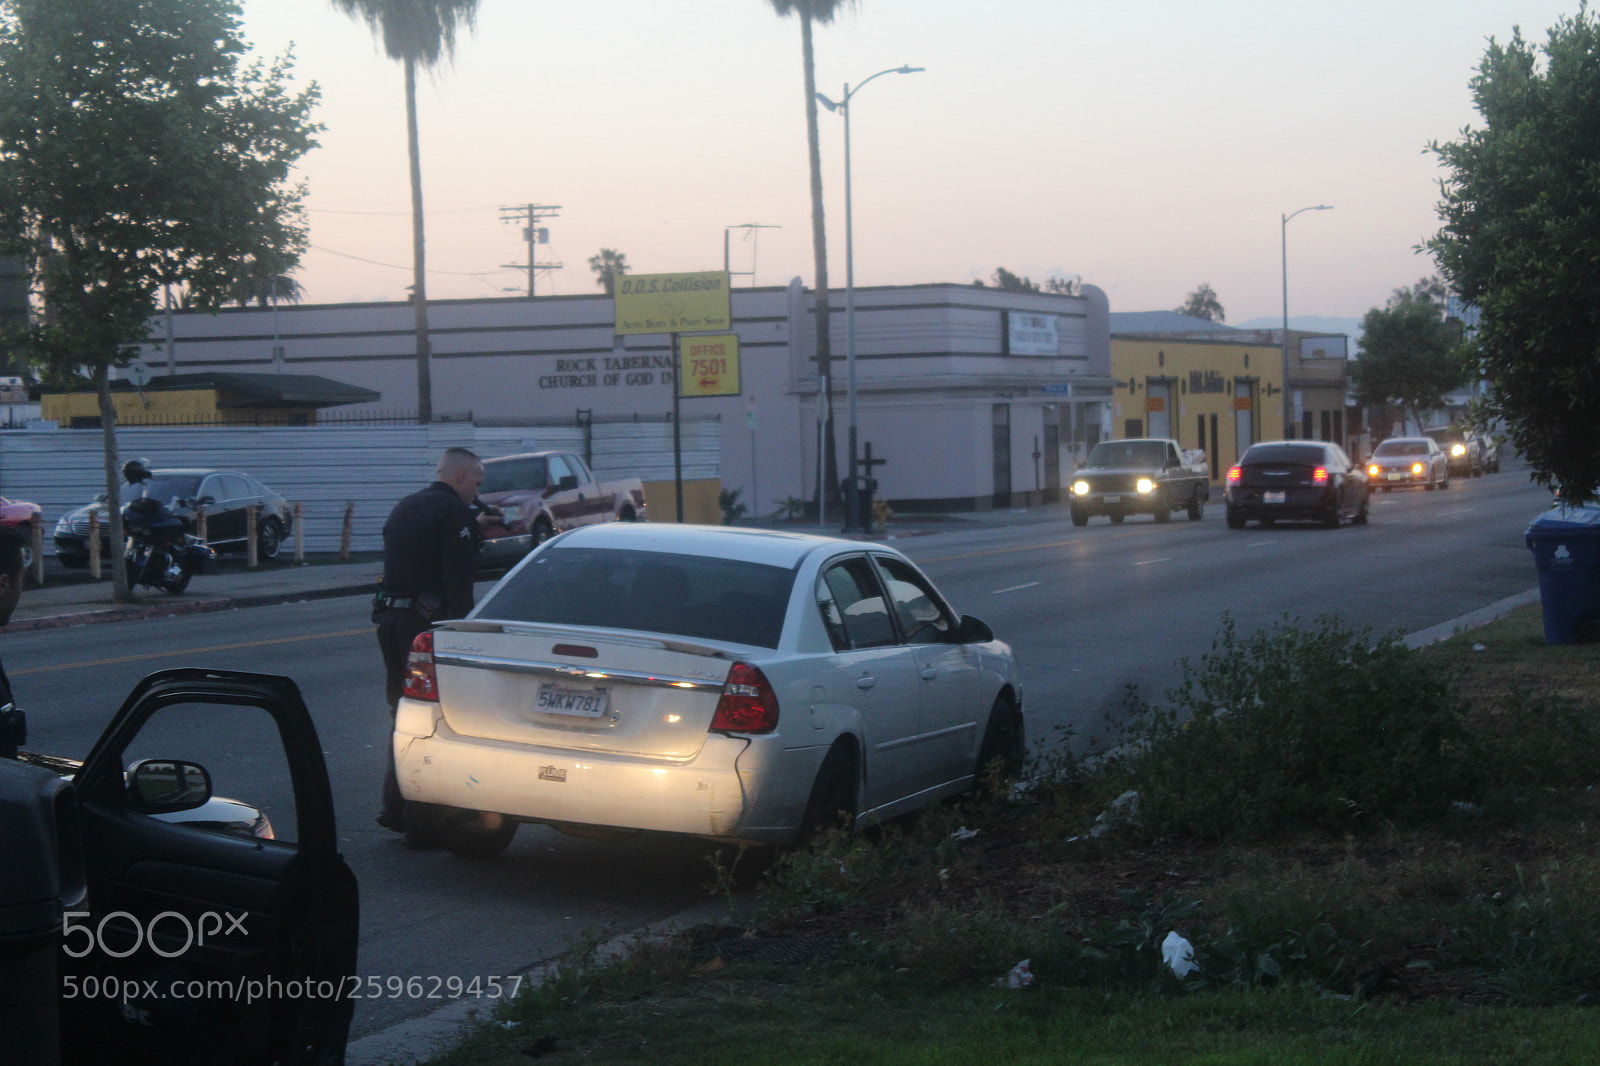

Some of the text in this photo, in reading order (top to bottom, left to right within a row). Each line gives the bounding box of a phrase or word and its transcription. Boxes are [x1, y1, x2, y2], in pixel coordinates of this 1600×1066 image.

[621, 277, 722, 294] D.D.S. Collision
[690, 343, 726, 356] OFFICE
[556, 355, 674, 372] ROCK TABERNA
[691, 358, 726, 376] 7501
[538, 374, 597, 389] CHURCH
[602, 373, 620, 386] OF
[626, 371, 654, 386] GOD
